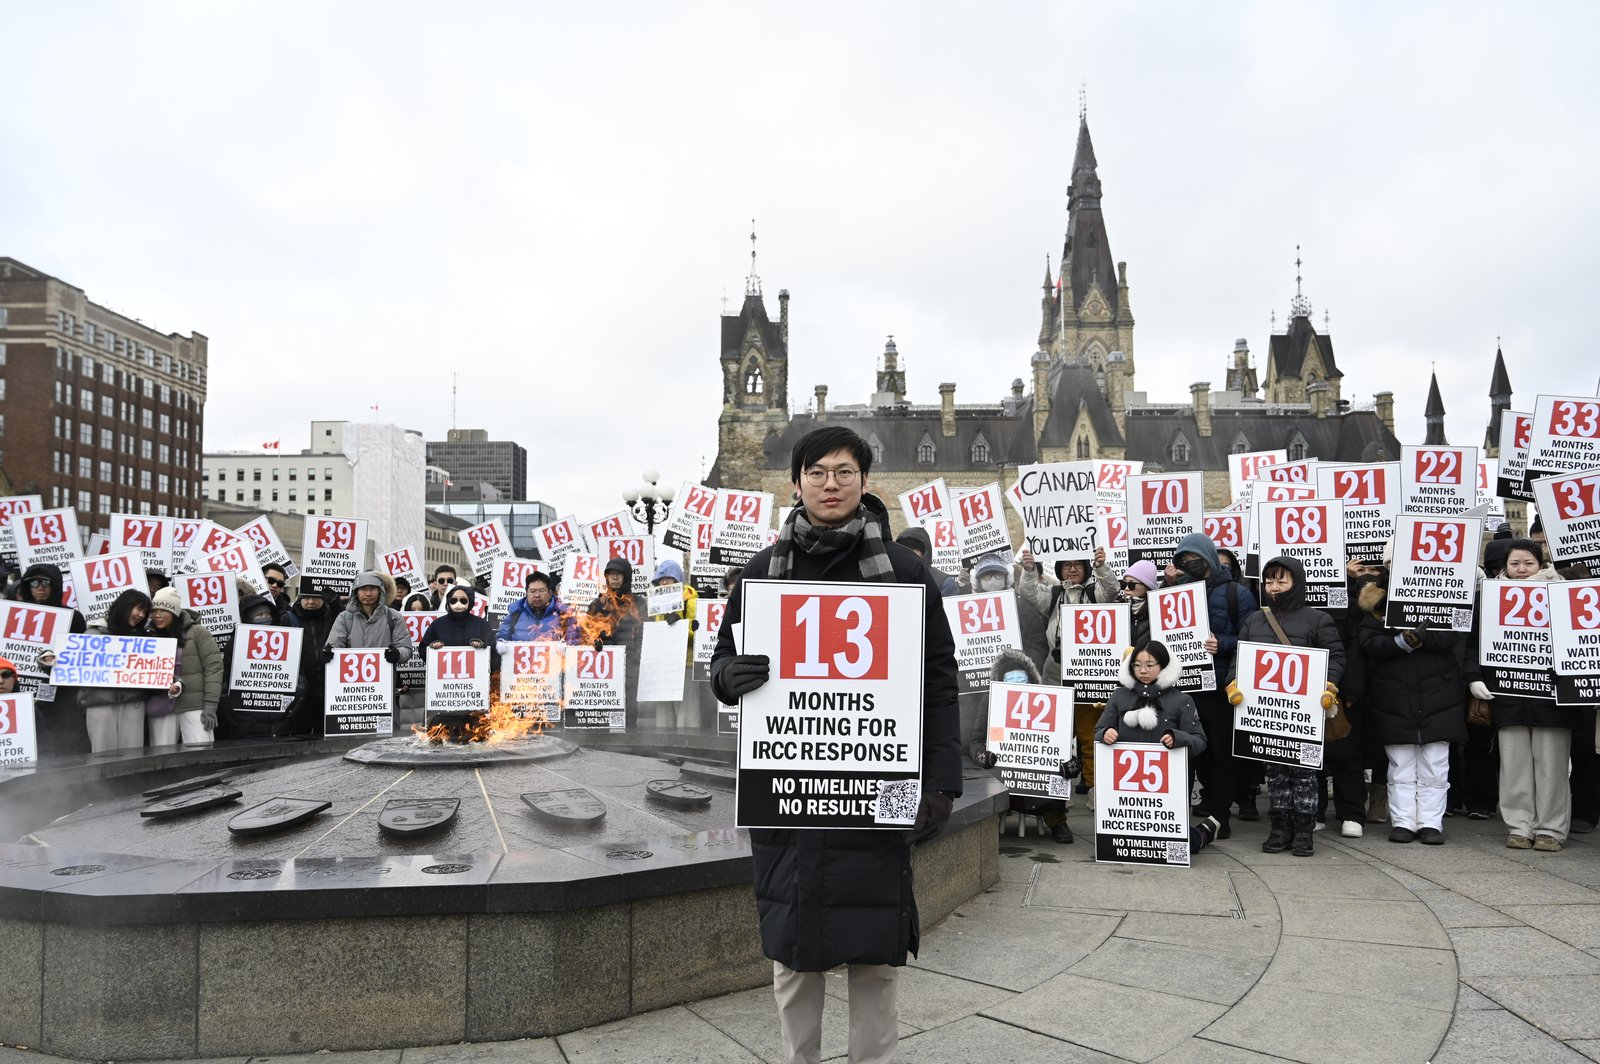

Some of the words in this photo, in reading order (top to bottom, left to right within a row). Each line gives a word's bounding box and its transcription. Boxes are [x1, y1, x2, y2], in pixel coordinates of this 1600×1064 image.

[1555, 401, 1599, 437] 33
[1552, 440, 1594, 450] MONTHS
[1540, 449, 1581, 460] WAITING
[1420, 452, 1457, 483] 22
[1532, 458, 1552, 468] IRCC
[1100, 464, 1127, 489] 23
[1503, 468, 1522, 478] IRCC
[1021, 471, 1096, 496] CANADA
[1340, 470, 1380, 505] 21
[1419, 487, 1456, 496] MONTHS
[687, 488, 714, 516] 27
[913, 487, 935, 516] 27
[1147, 480, 1183, 513] 70
[1410, 496, 1446, 505] WAITING
[1448, 497, 1465, 505] FOR
[729, 496, 758, 522] 42
[963, 494, 988, 525] 13
[1023, 506, 1064, 528] WHAT
[1066, 505, 1094, 525] ARE
[1405, 504, 1424, 513] IRCC
[727, 524, 754, 532] MONTHS
[1146, 517, 1183, 525] MONTHS
[1281, 507, 1322, 543] 68
[1372, 520, 1391, 528] FOR
[31, 516, 62, 544] 43
[128, 520, 157, 546] 27
[321, 522, 351, 549] 39
[472, 525, 496, 550] 39
[547, 523, 569, 544] 19
[968, 523, 992, 536] MONTHS
[1138, 527, 1174, 535] WAITING
[1205, 518, 1238, 546] 23
[964, 532, 987, 546] WAITING
[989, 530, 1000, 538] FOR
[975, 537, 1005, 551] RESPONSE
[1026, 536, 1050, 555] YOU
[1053, 526, 1097, 552] DOING?
[1418, 523, 1459, 562] 53
[34, 545, 65, 555] MONTHS
[614, 540, 640, 565] 30
[1281, 548, 1322, 556] MONTHS
[1556, 546, 1579, 556] IRCC
[388, 552, 411, 574] 25
[1414, 566, 1455, 576] MONTHS
[91, 558, 127, 590] 40
[1402, 577, 1443, 587] WAITING
[1445, 578, 1464, 588] FOR
[192, 577, 222, 606] 39
[1395, 588, 1417, 597] IRCC
[1418, 589, 1468, 600] RESPONSE
[1164, 591, 1191, 629] 30
[1403, 604, 1415, 613] NO
[1504, 587, 1549, 627] 28
[963, 599, 1000, 632] 34
[10, 608, 46, 642] 11
[1079, 610, 1112, 643] 30
[66, 635, 111, 652] STOP
[119, 638, 156, 653] THE
[795, 596, 874, 678] 13
[967, 635, 1002, 646] MONTHS
[1166, 631, 1194, 642] MONTHS
[1504, 631, 1549, 641] MONTHS
[252, 631, 284, 659] 39
[959, 646, 994, 656] WAITING
[1079, 648, 1112, 656] MONTHS
[1188, 642, 1202, 651] FOR
[1493, 642, 1536, 653] WAITING
[443, 652, 469, 678] 11
[517, 646, 546, 673] 35
[581, 651, 609, 678] 20
[1486, 653, 1508, 663] IRCC
[1562, 660, 1586, 670] IRCC
[344, 654, 376, 682] 36
[1259, 651, 1303, 694] 20
[1496, 670, 1507, 678] NO
[1499, 680, 1511, 688] NO
[1512, 682, 1551, 692] RESULTS
[1574, 679, 1588, 687] NO
[1580, 689, 1593, 697] NO
[789, 692, 874, 711] MONTHS
[1258, 696, 1300, 709] MONTHS
[1011, 692, 1051, 730] 42
[1247, 706, 1288, 719] WAITING
[1291, 712, 1311, 723] FOR
[766, 716, 851, 735] WAITING
[858, 718, 896, 736] FOR
[1241, 717, 1262, 728] IRCC
[1263, 721, 1316, 736] RESPONSE
[1010, 732, 1050, 743] MONTHS
[1250, 735, 1260, 744] NO
[753, 741, 798, 759] IRCC
[801, 743, 908, 762] RESPONSE
[1000, 742, 1039, 754] WAITING
[1042, 745, 1060, 756] FOR
[1252, 745, 1264, 753] NO
[1265, 747, 1300, 759] RESULTS
[1119, 750, 1163, 792] 25
[772, 778, 795, 794] NO
[1017, 781, 1050, 791] RESULTS
[779, 799, 802, 814] NO
[807, 800, 876, 815] RESULTS
[1119, 797, 1163, 808] MONTHS
[1108, 808, 1151, 819] WAITING
[1154, 811, 1175, 820] FOR
[1102, 820, 1125, 830] IRCC
[1126, 822, 1181, 833] RESPONSE
[1113, 838, 1124, 846] NO
[1117, 849, 1128, 857] NO
[1131, 849, 1167, 859] RESULTS
